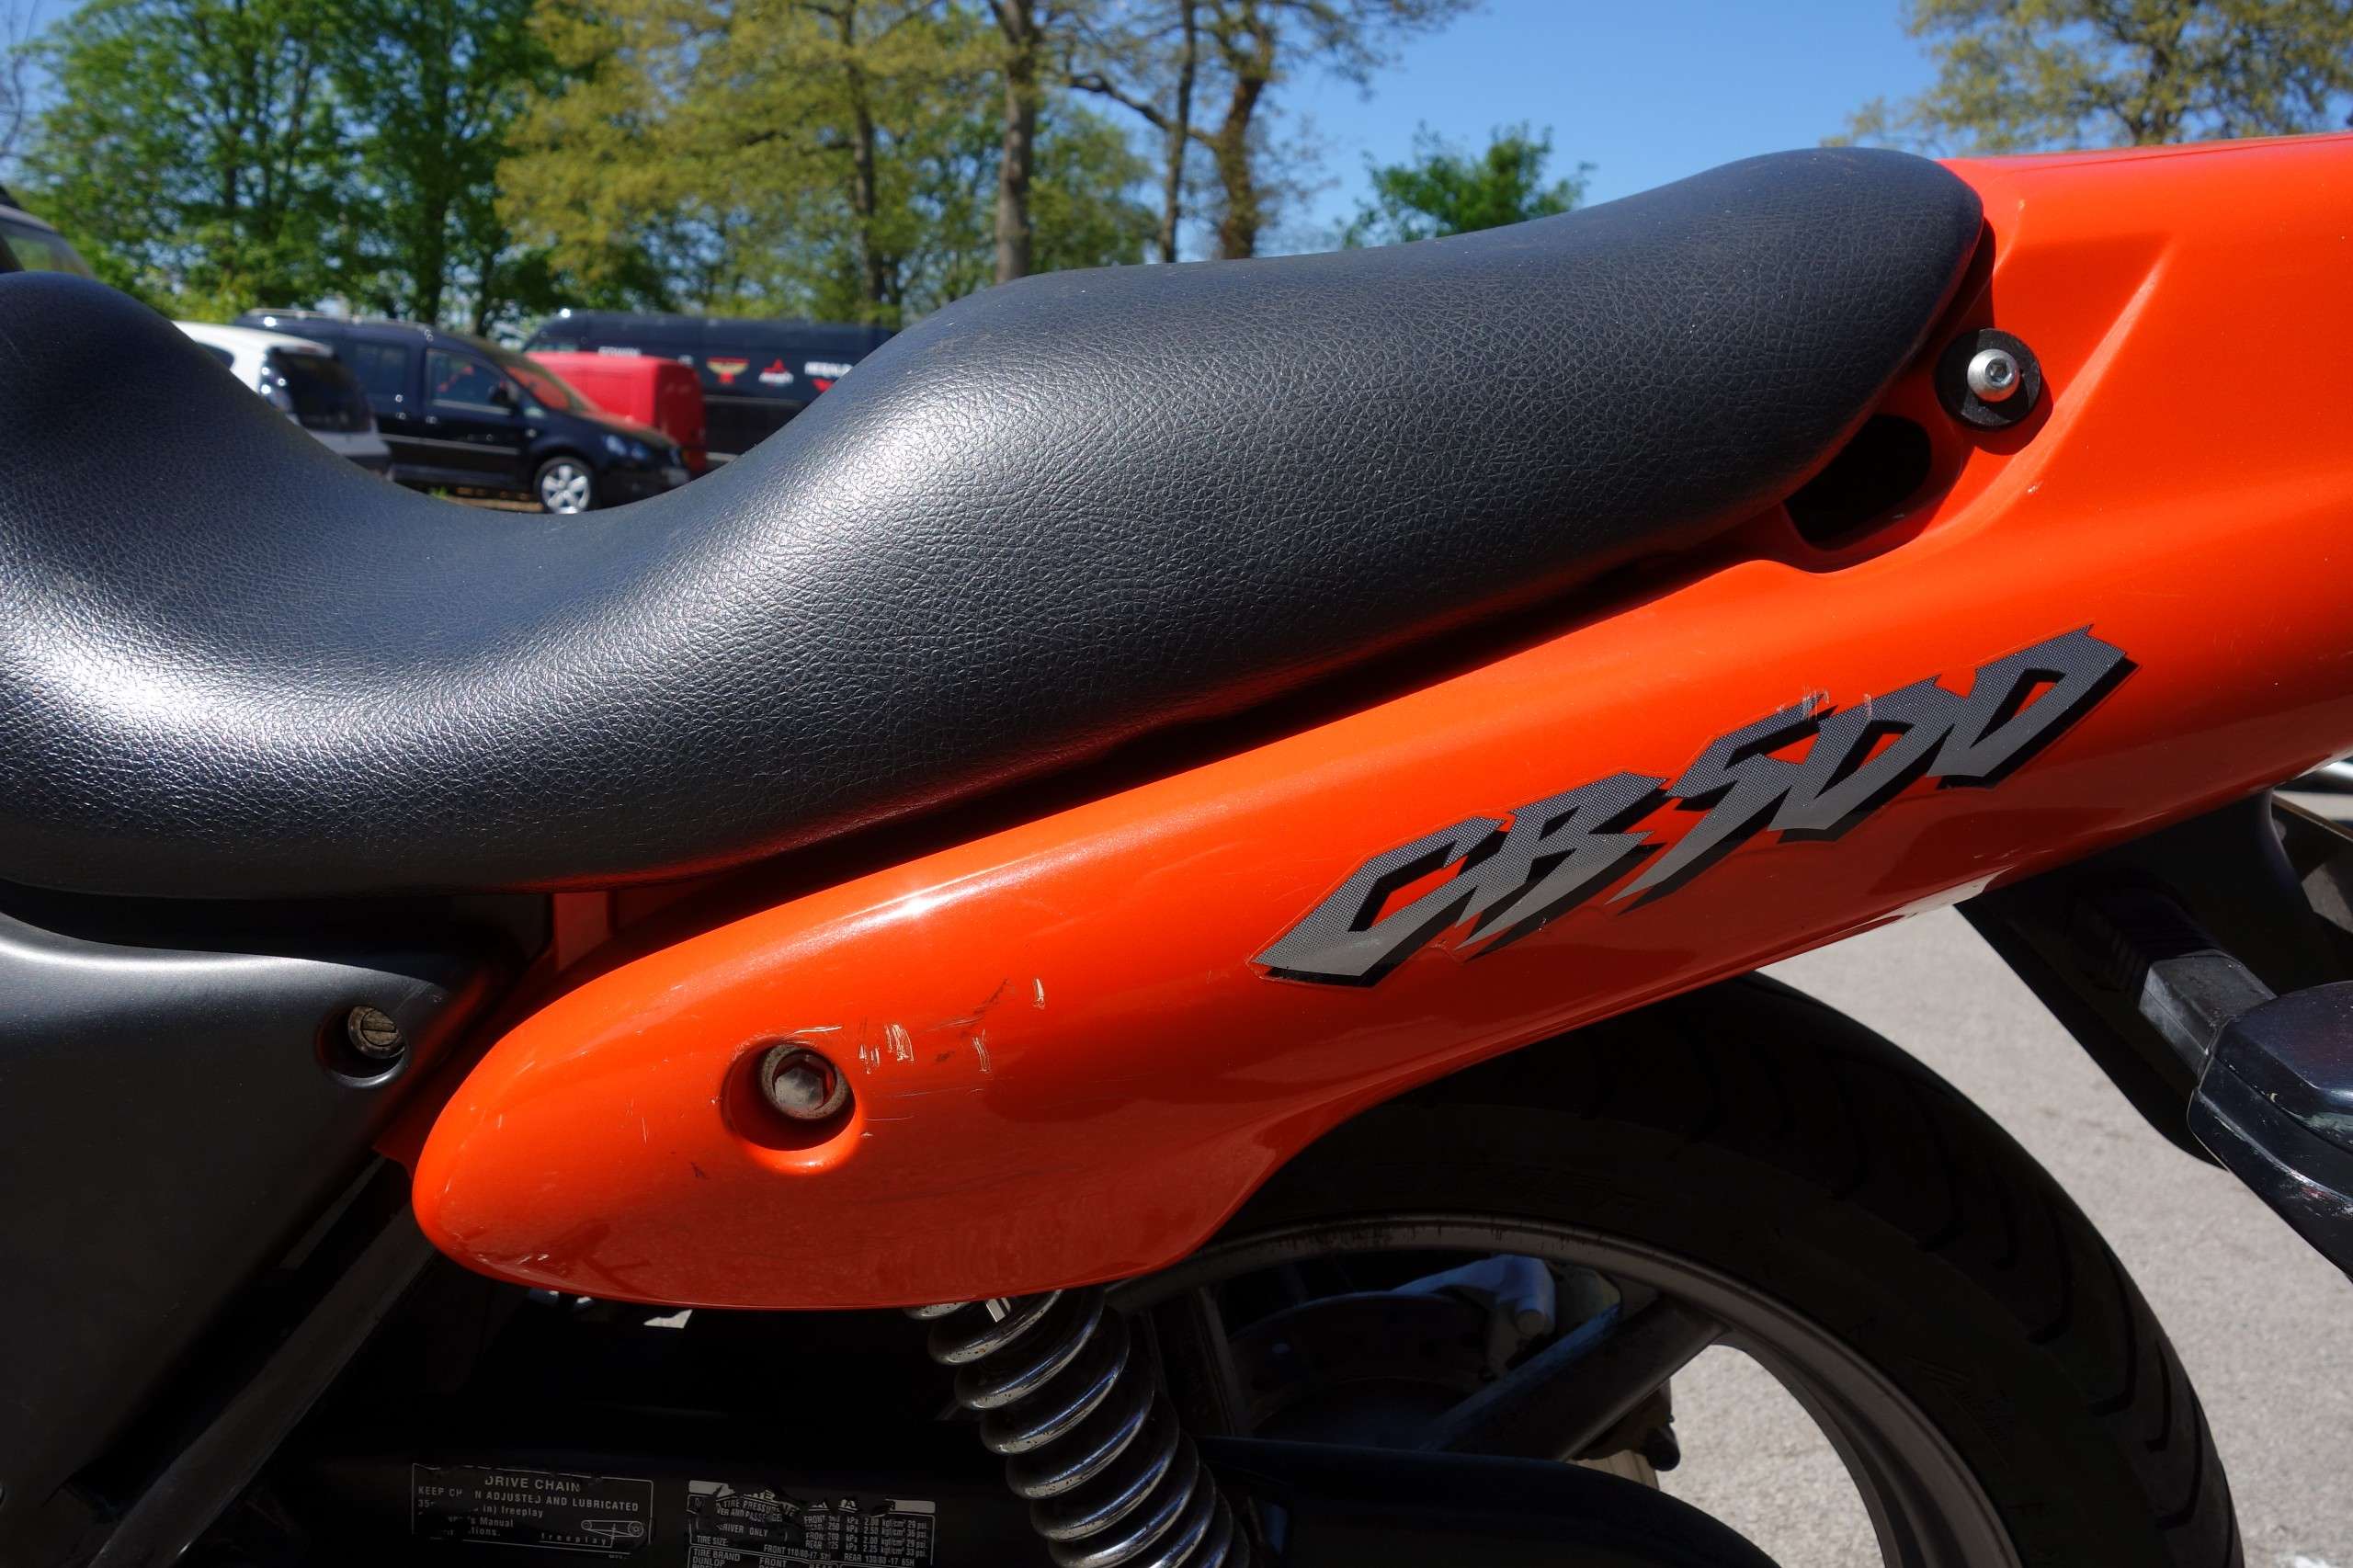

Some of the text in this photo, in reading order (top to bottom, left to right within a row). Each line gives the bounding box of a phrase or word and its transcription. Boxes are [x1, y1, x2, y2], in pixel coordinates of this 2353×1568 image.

[484, 1475, 582, 1494] DRIVE CHAIN
[417, 1485, 445, 1496] KEEP
[545, 1495, 568, 1506] AND
[573, 1499, 640, 1512] LUBRICATED
[501, 1506, 544, 1519] freeplay
[479, 1517, 515, 1528] Manual
[749, 1527, 768, 1537] ONLY
[694, 1548, 741, 1562] TIRE BRAND
[764, 1544, 787, 1555] FRONT
[692, 1556, 726, 1567] DUNLOP
[844, 1552, 862, 1562] REAR
